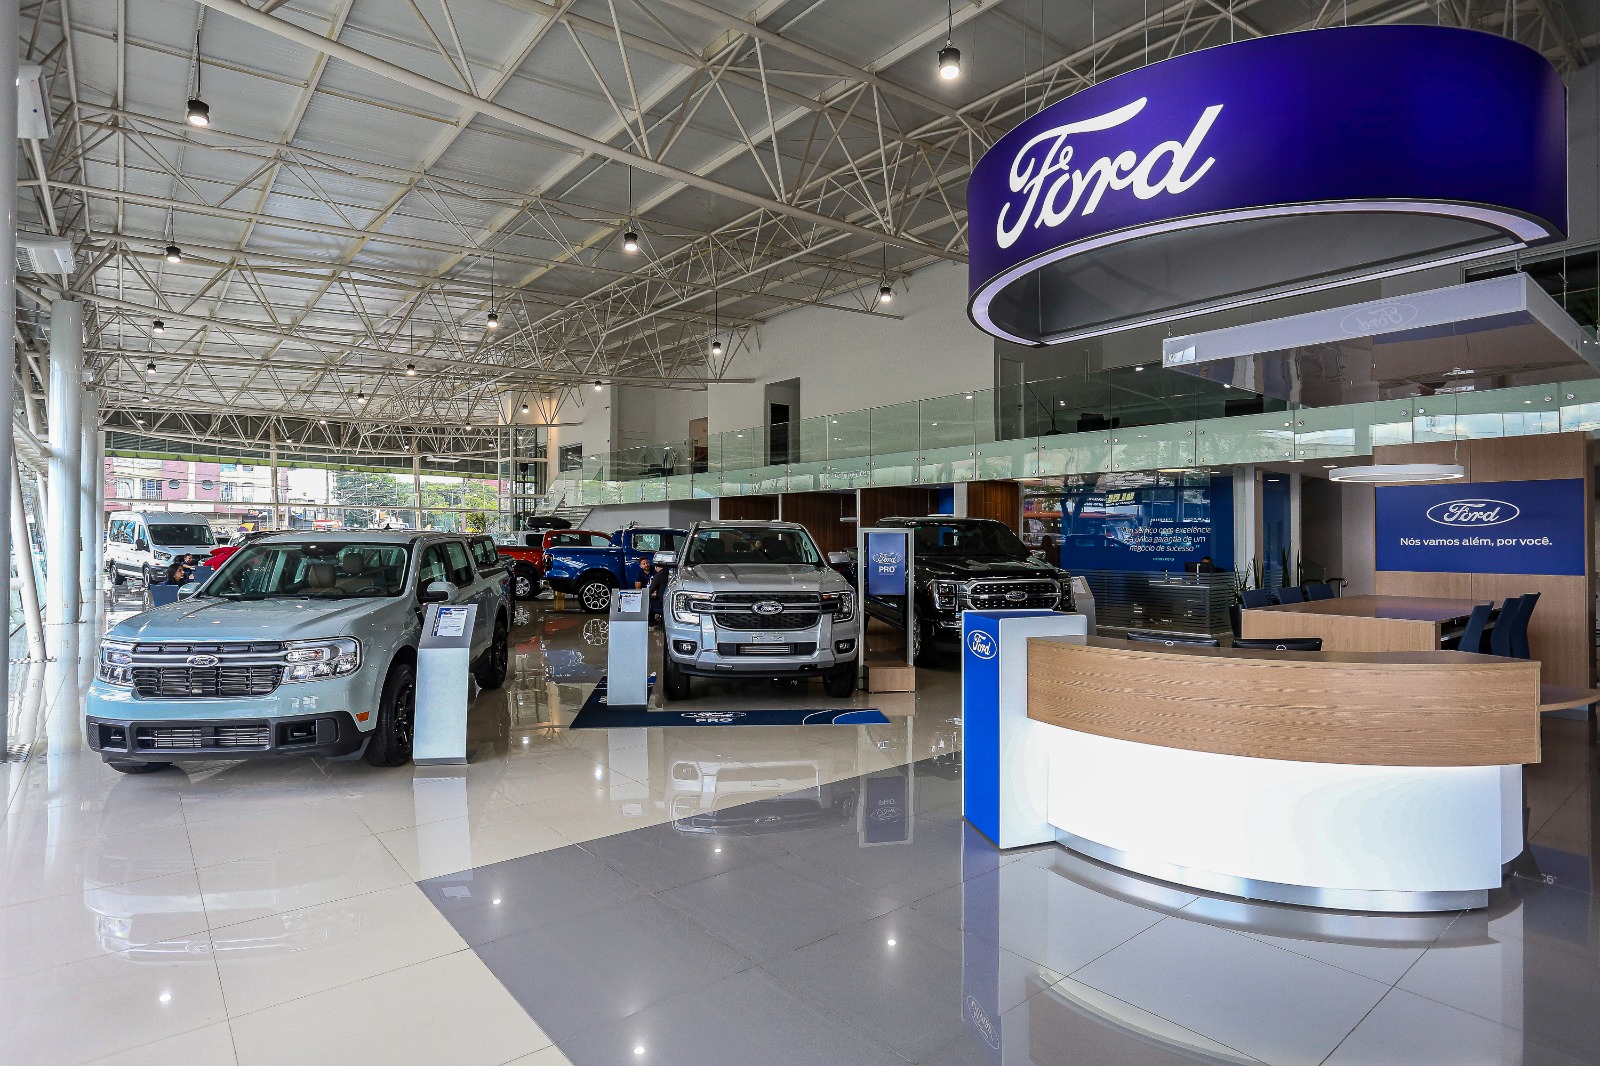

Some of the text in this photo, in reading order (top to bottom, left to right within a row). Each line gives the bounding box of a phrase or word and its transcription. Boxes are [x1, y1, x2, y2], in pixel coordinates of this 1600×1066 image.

[997, 97, 1223, 248] Ford
[1443, 503, 1500, 522] Ford
[1154, 535, 1182, 544] garantia
[1183, 534, 1192, 543] de
[1400, 536, 1553, 547] Nós vamos além, por você.
[1129, 544, 1155, 553] negócio
[1156, 543, 1165, 551] de
[878, 565, 896, 573] PRO
[972, 633, 991, 655] Ford
